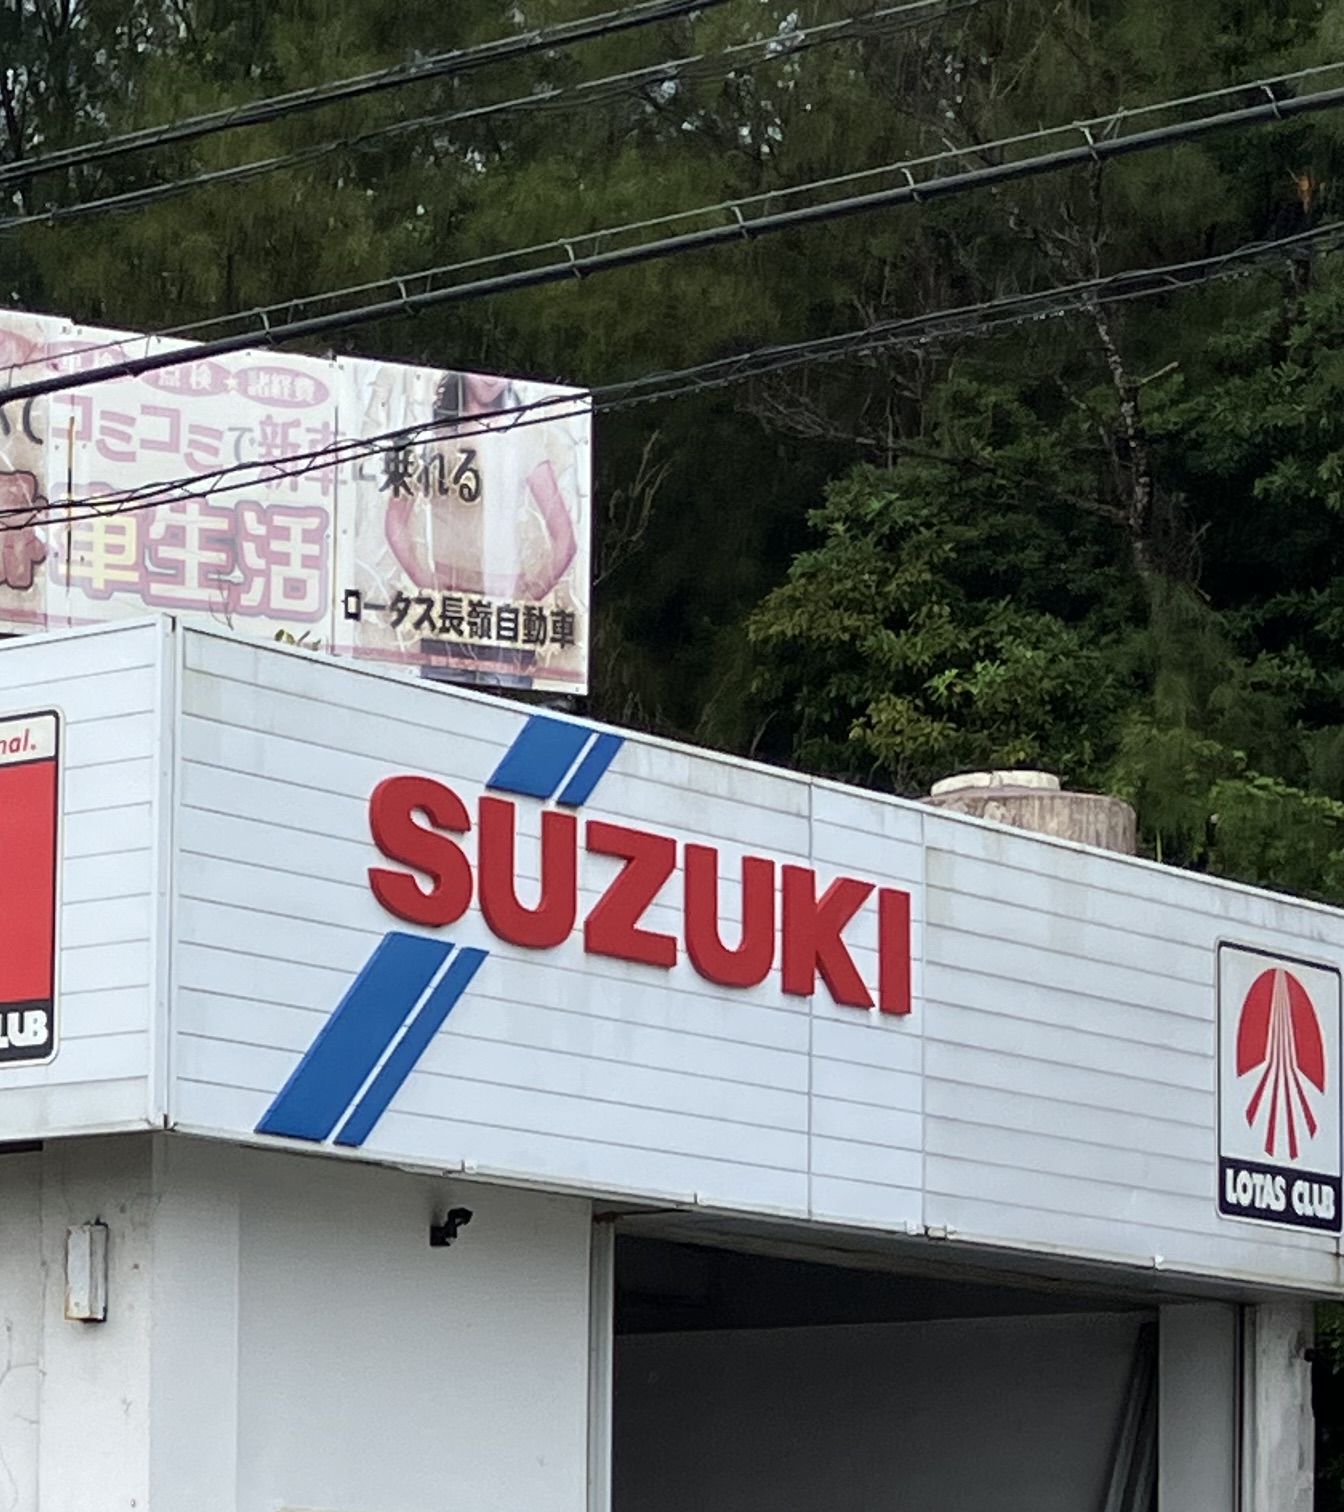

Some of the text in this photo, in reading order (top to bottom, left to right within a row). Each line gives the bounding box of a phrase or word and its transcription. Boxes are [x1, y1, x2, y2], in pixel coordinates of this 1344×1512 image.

[367, 774, 912, 1016] SUZUKI
[1225, 1167, 1336, 1220] LOTAS CLUB
